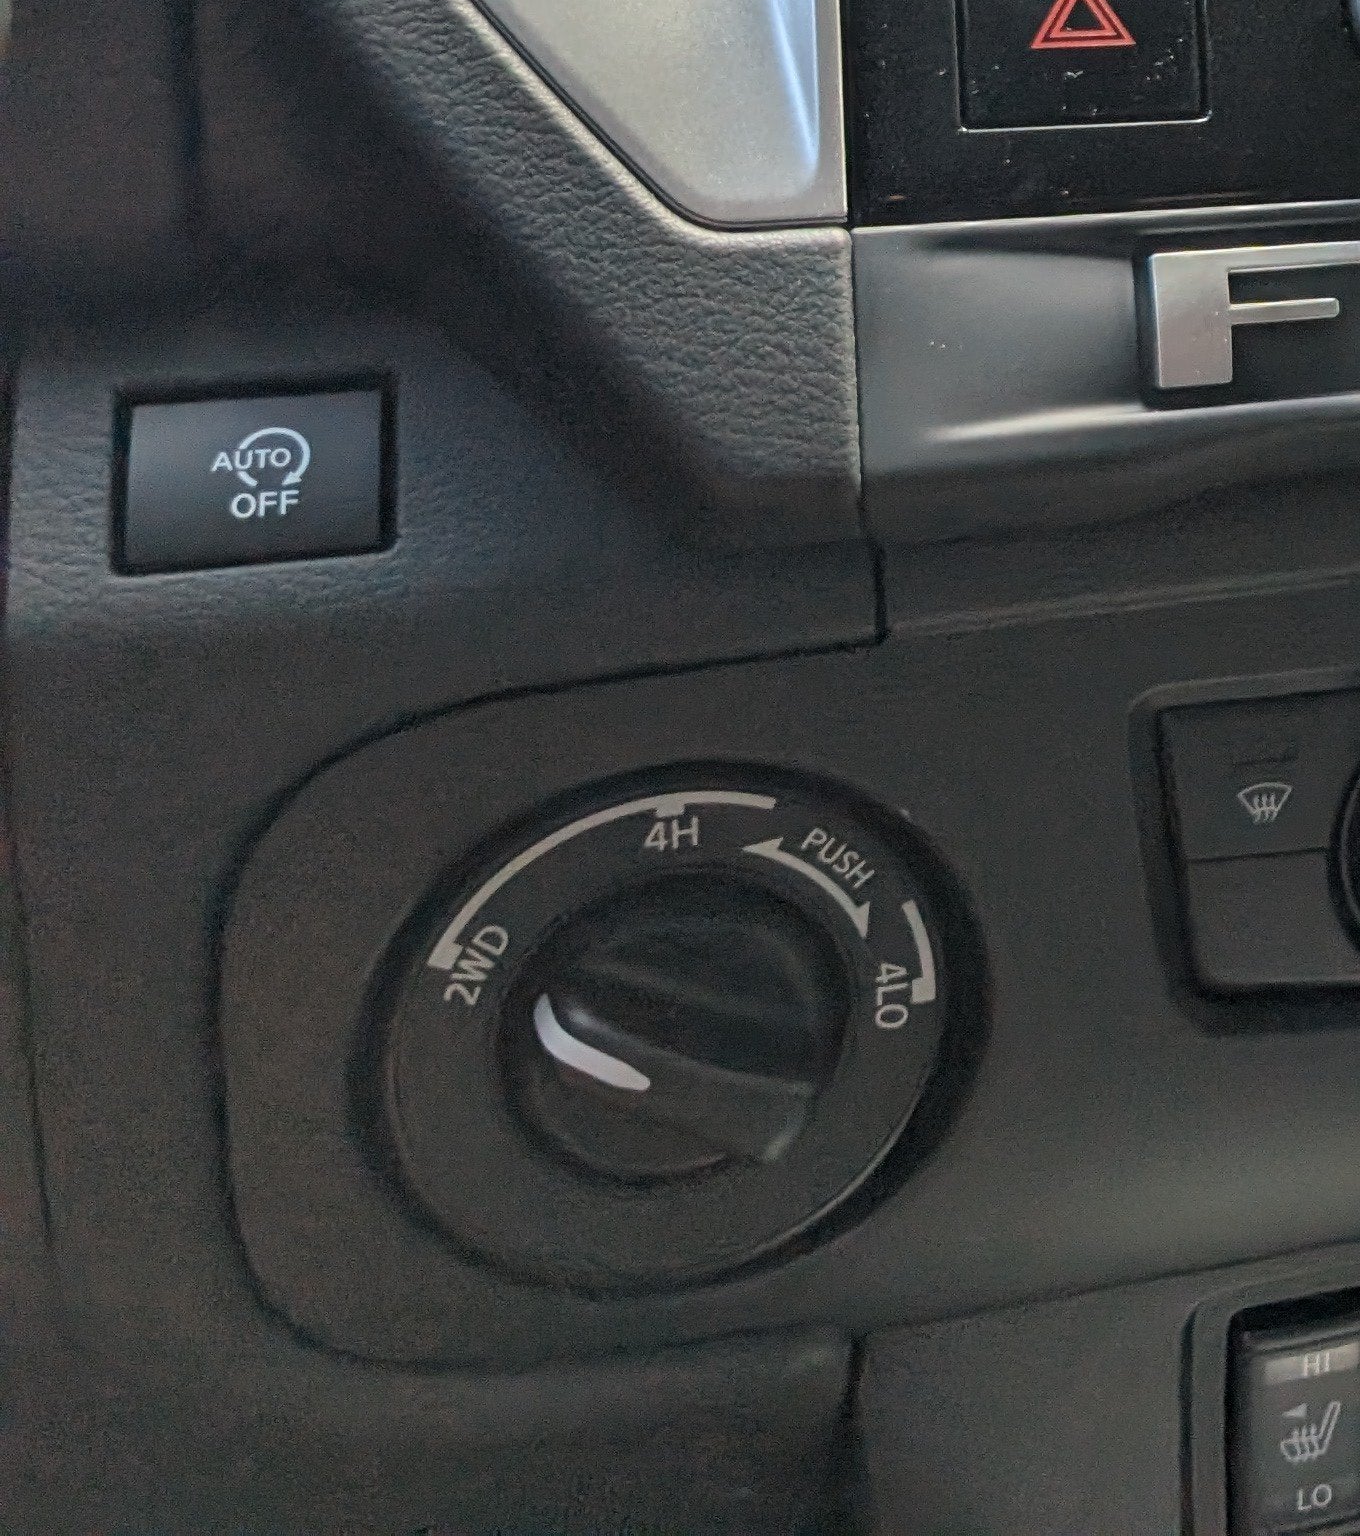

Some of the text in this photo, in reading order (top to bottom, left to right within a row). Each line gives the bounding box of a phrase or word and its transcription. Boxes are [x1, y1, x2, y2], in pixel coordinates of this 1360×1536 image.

[210, 447, 292, 473] AUTO
[229, 489, 300, 519] OFF
[642, 816, 700, 852] 4H
[799, 827, 875, 891] PUSH
[443, 924, 509, 1007] 2WD
[874, 961, 910, 1031] 4LO
[1302, 1351, 1332, 1375] HI
[1296, 1483, 1333, 1512] LO
